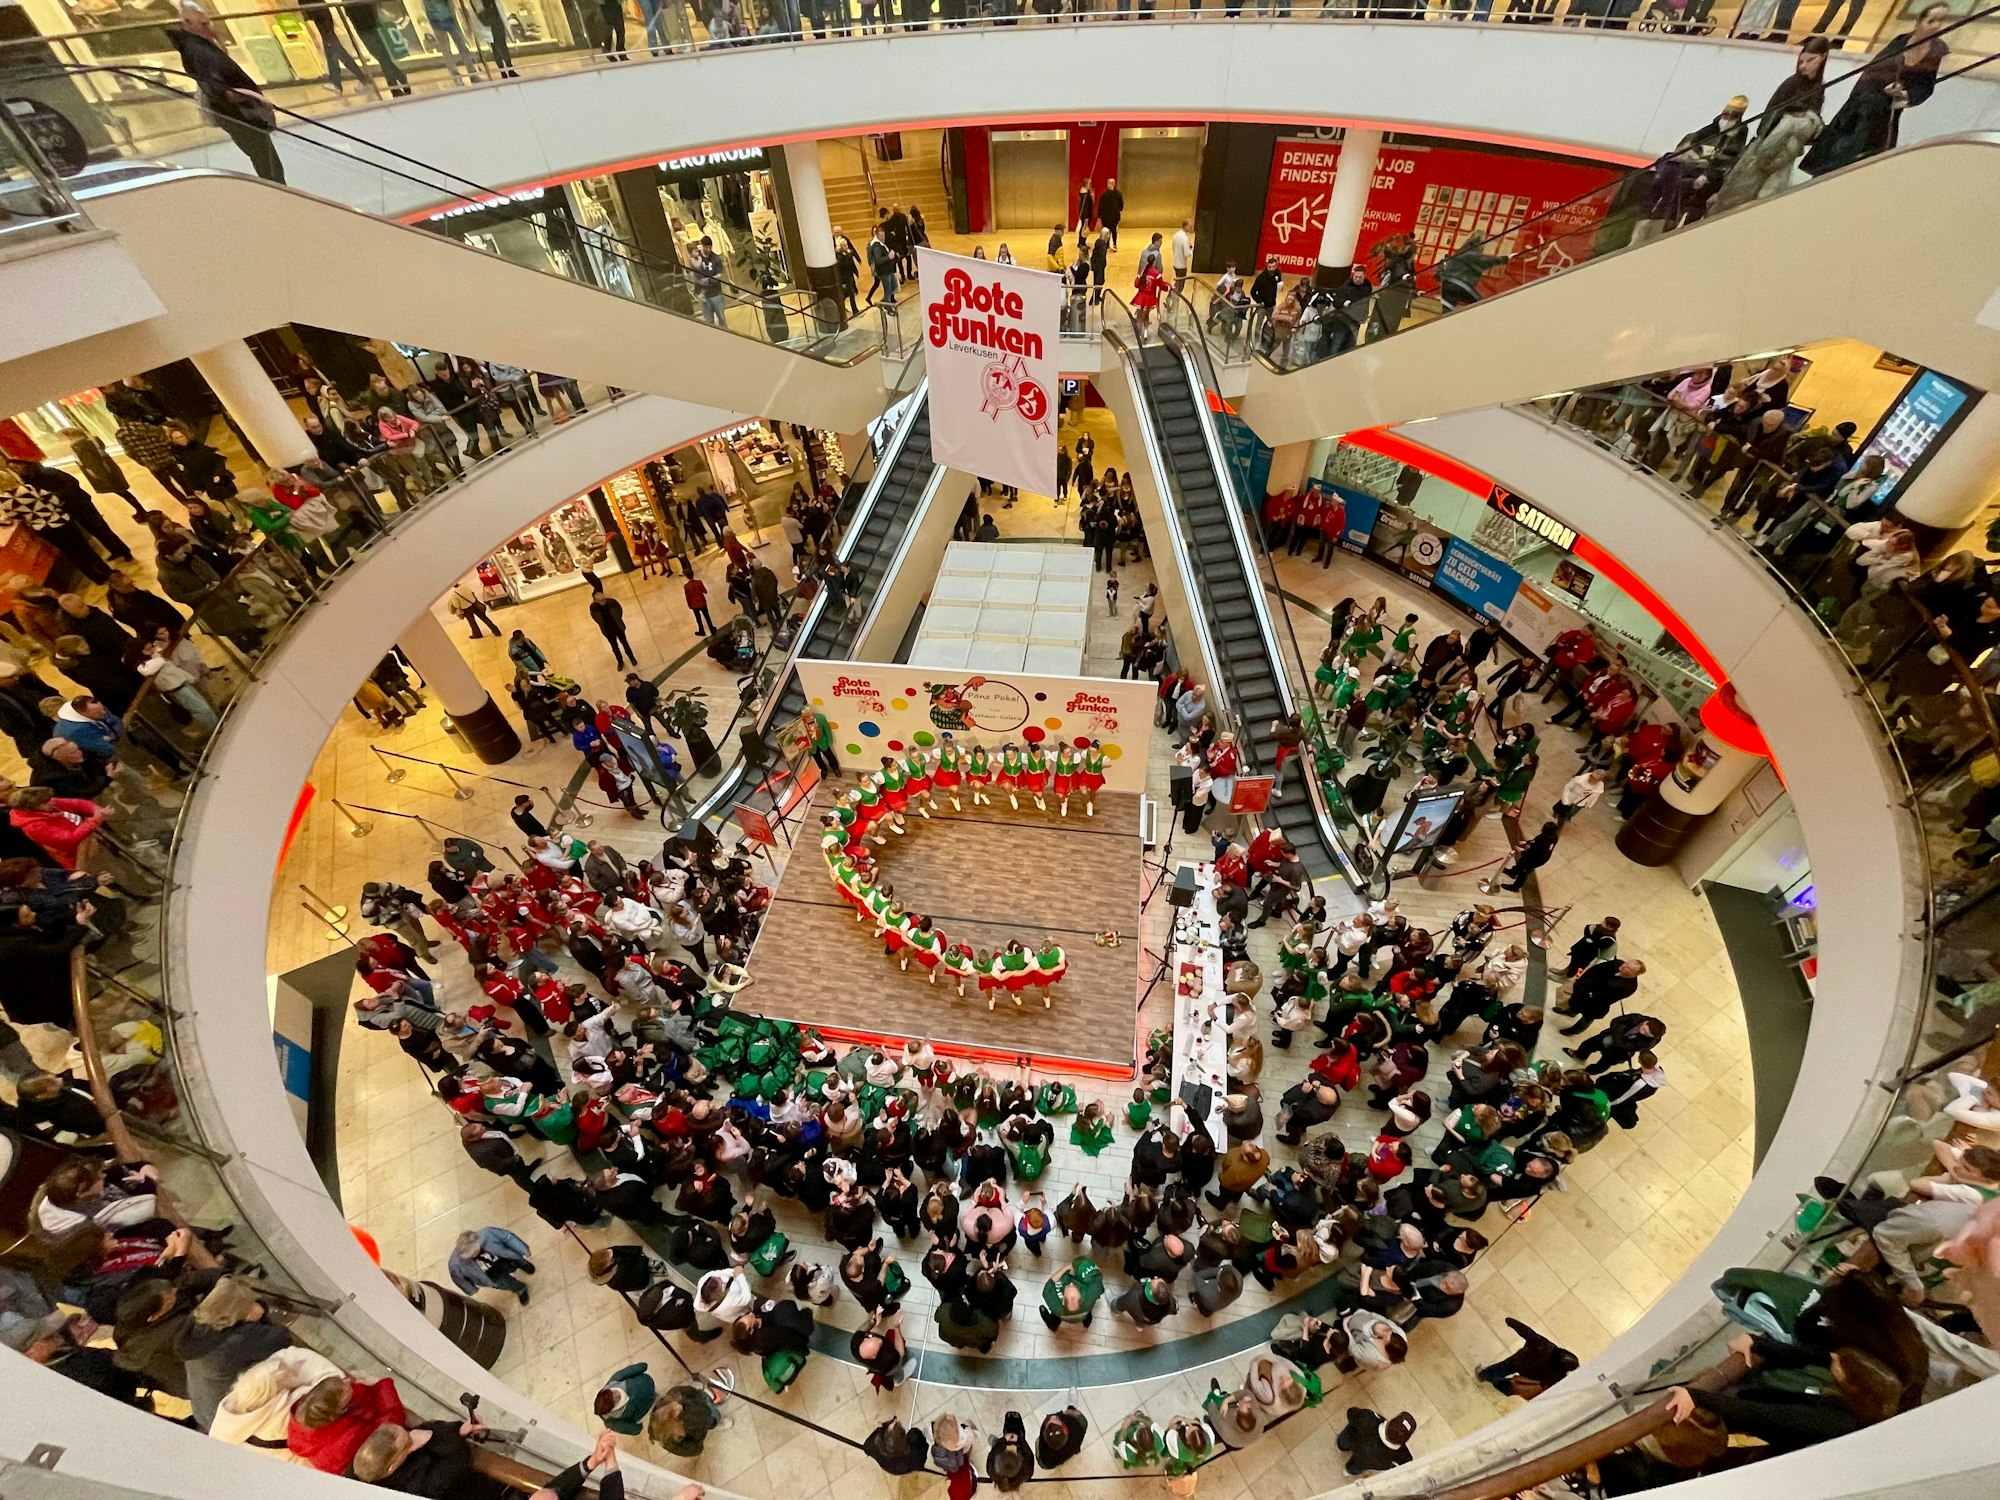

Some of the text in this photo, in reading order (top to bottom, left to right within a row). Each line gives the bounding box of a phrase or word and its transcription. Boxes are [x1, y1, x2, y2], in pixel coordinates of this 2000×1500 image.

[1282, 151, 1334, 167] DEINEN
[1385, 159, 1415, 174] JOB
[1280, 168, 1395, 190] FINDEST IER
[1363, 208, 1401, 223] ÄRKUNG
[944, 268, 1023, 320] Rote
[928, 303, 1043, 360] Funken
[949, 339, 998, 360] Leverkusen
[1066, 380, 1076, 391] P
[1515, 503, 1576, 550] SATURN
[1447, 556, 1477, 579] ZU GELD
[1443, 565, 1480, 592] MACHEN?
[1475, 613, 1489, 626] SATU
[832, 686, 880, 696] Funken
[838, 676, 870, 688] Rote
[968, 692, 1020, 702] Pänz Pokal
[1074, 692, 1110, 704] Rote
[1066, 701, 1117, 713] Funken
